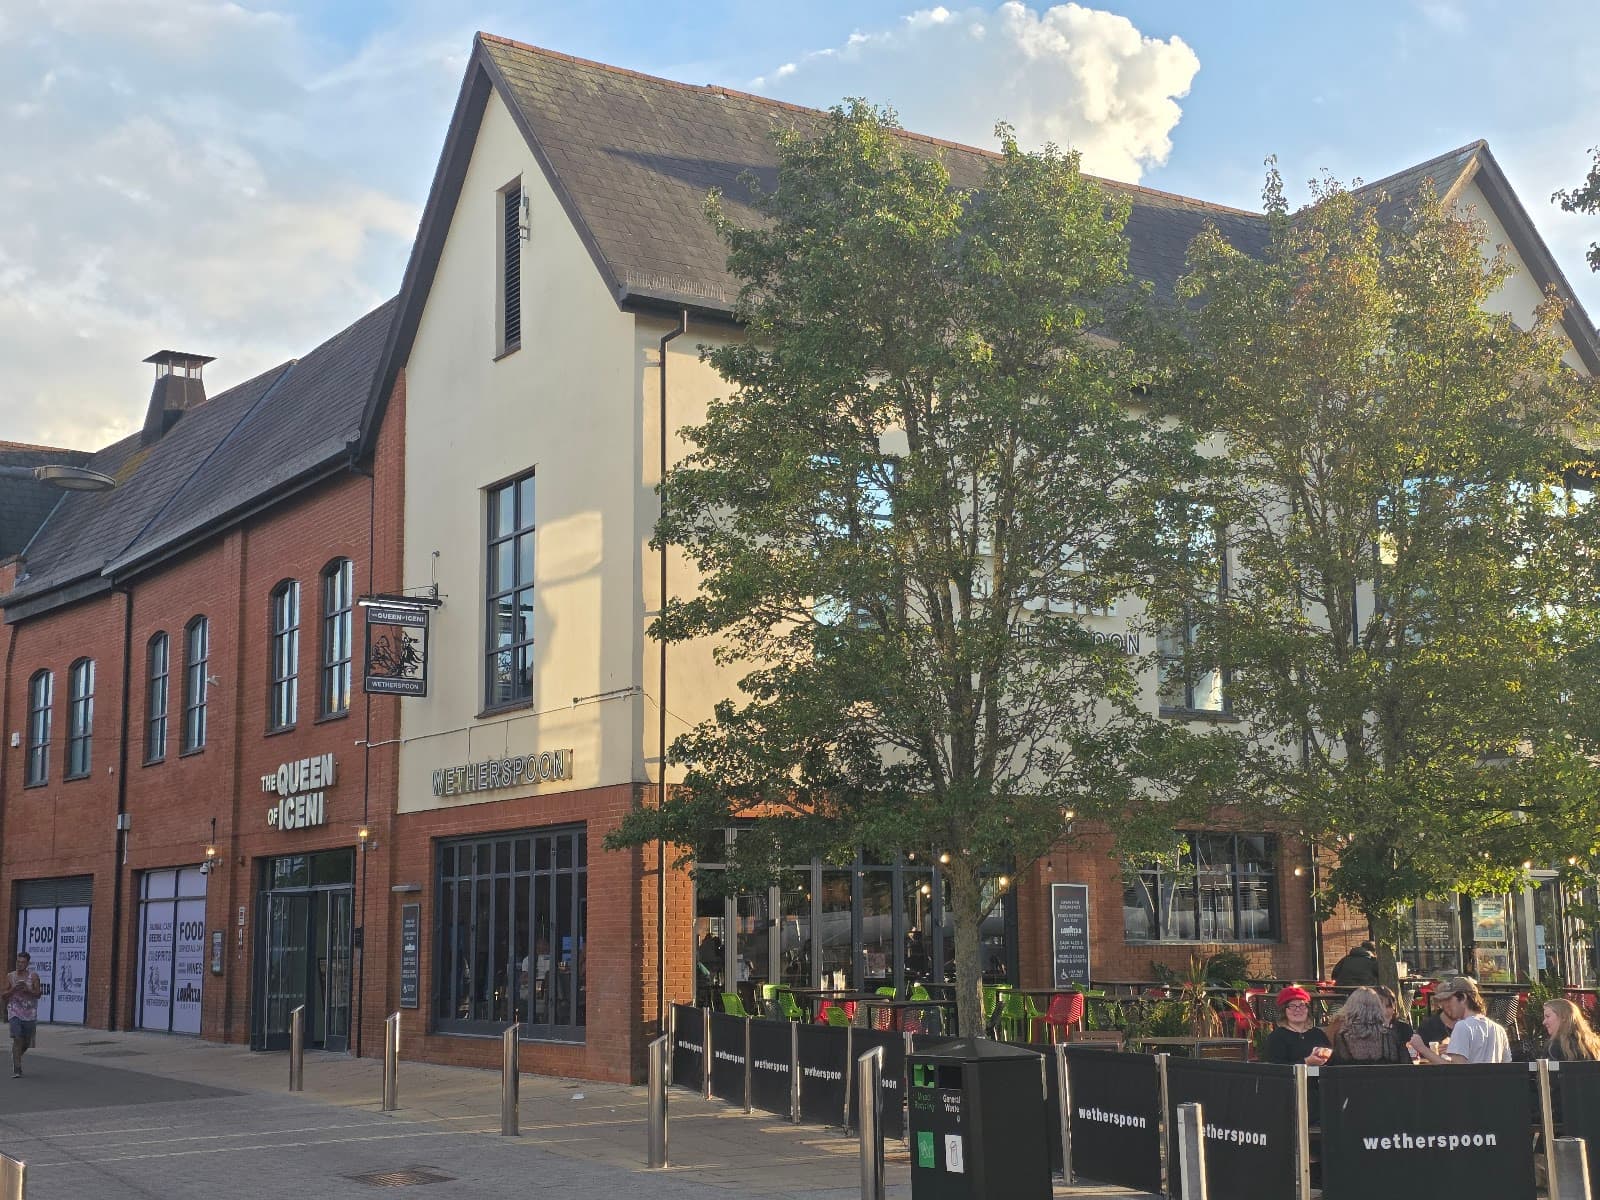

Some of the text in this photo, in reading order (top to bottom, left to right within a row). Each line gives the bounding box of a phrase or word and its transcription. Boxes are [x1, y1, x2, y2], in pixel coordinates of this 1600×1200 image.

[378, 612, 402, 620] QUEEN
[372, 681, 419, 690] WETHERSPOON
[261, 752, 333, 796] THE QUEEN
[432, 750, 565, 796] WETHERSPOON
[268, 792, 324, 830] OF ICENI
[30, 926, 54, 944] FOOD
[180, 922, 204, 940] FOOD
[942, 1094, 961, 1104] General
[945, 1103, 960, 1113] Waste
[1078, 1107, 1146, 1128] wetherspoon
[1202, 1123, 1267, 1145] etherspoon
[1363, 1132, 1496, 1150] wetherspoon
